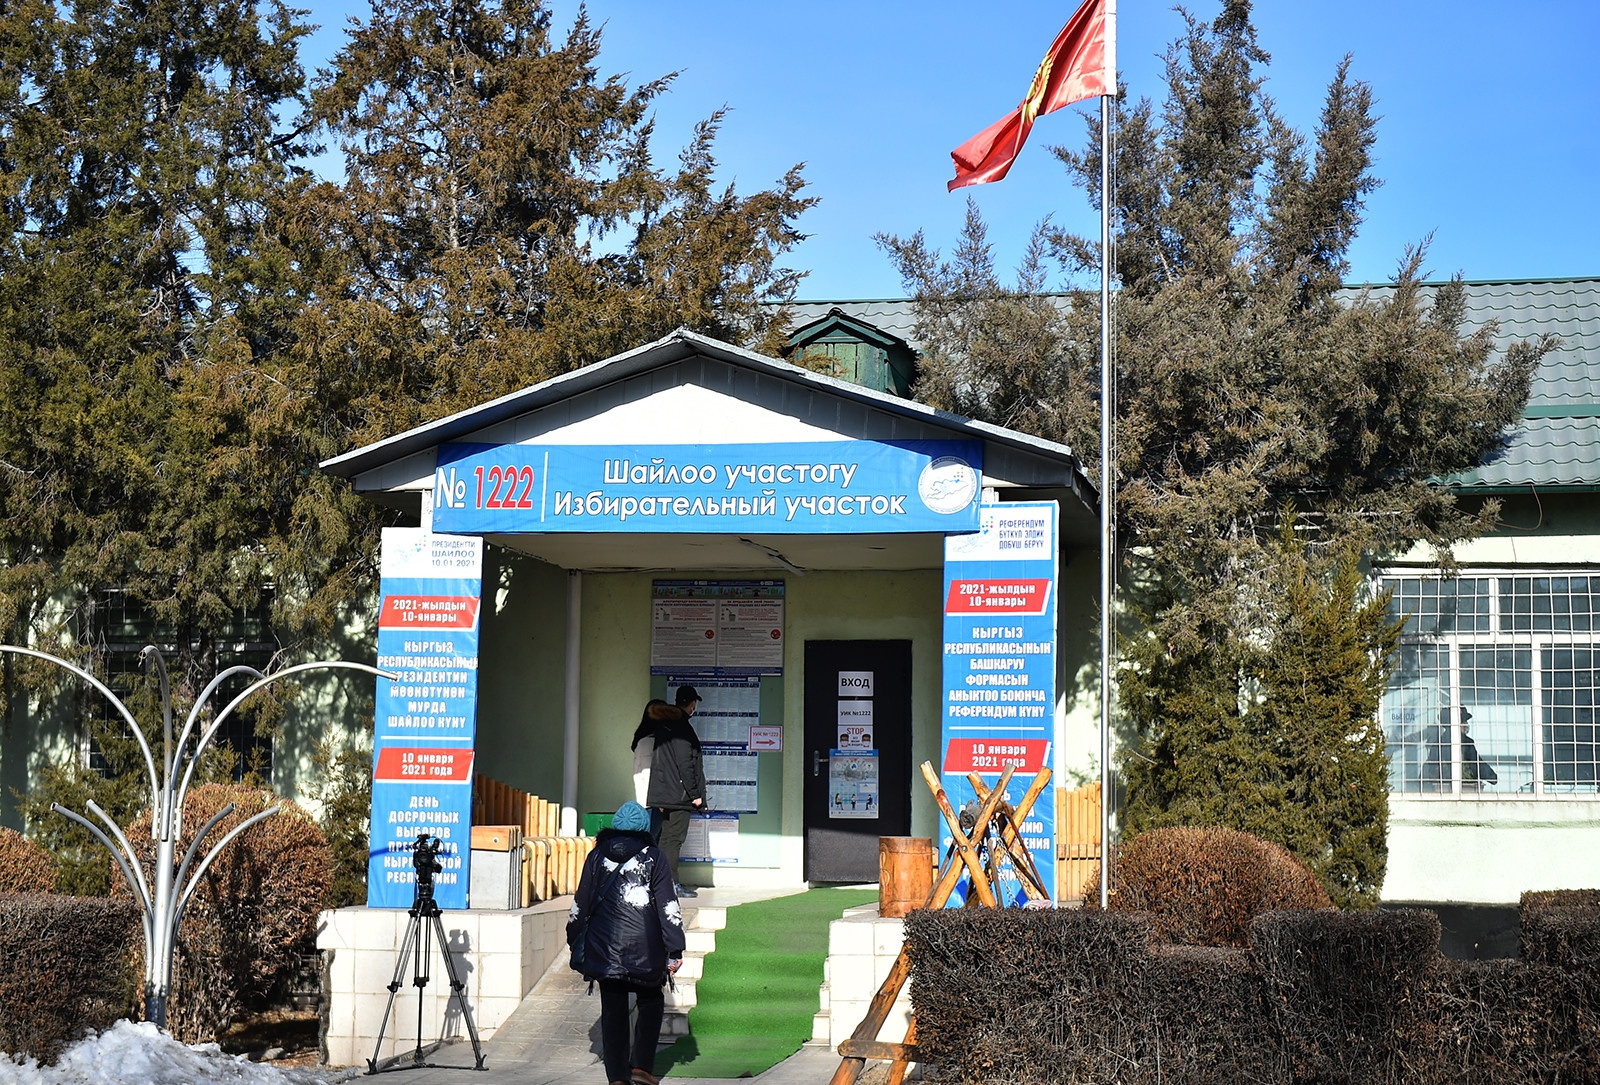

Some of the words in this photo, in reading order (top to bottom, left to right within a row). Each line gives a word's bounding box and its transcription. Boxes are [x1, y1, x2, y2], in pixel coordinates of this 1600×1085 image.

[603, 458, 717, 485] Шайлоо
[724, 460, 859, 491] участогу
[436, 467, 467, 508] №
[474, 465, 534, 511] 1222
[553, 489, 776, 521] Избирательный
[785, 494, 907, 523] участок
[999, 519, 1045, 529] РЕФЕРЕНДУМ
[959, 583, 1035, 595] 2021-жылдын
[393, 599, 466, 611] 2021-жылдын
[969, 595, 1026, 607] 10-январы
[402, 611, 457, 623] 10-январы
[972, 626, 1024, 639] КЫРГЫЗ
[404, 641, 454, 653] КЫРГЫЗ
[944, 642, 1051, 655] РЕСПУБЛИКАСЫНЫН
[970, 658, 1025, 670] БАШКАРУУ
[841, 678, 870, 689] ВХОД
[965, 673, 1029, 686] ФОРМАСЫН
[948, 689, 998, 702] АНЫКТОО
[1000, 689, 1046, 702] БОЮНЧА
[408, 701, 447, 714] МУРДА
[949, 705, 1017, 719] РЕФЕРЕНДУМ
[387, 715, 435, 728] ШАЙЛОО
[1391, 713, 1415, 721] ВЫОД
[847, 727, 865, 735] STOP
[972, 743, 985, 754] 10
[988, 745, 1027, 755] января
[402, 753, 414, 763] 10
[418, 755, 454, 764] января
[972, 756, 998, 767] 2021
[402, 765, 426, 775] 2021
[430, 767, 453, 776] года
[409, 796, 439, 809] ДЕНЬ
[388, 811, 460, 824] ДОСРОЧНЫХ
[384, 855, 462, 868] КЫРГКОЙ
[386, 872, 458, 884] РЕСПИКИ
